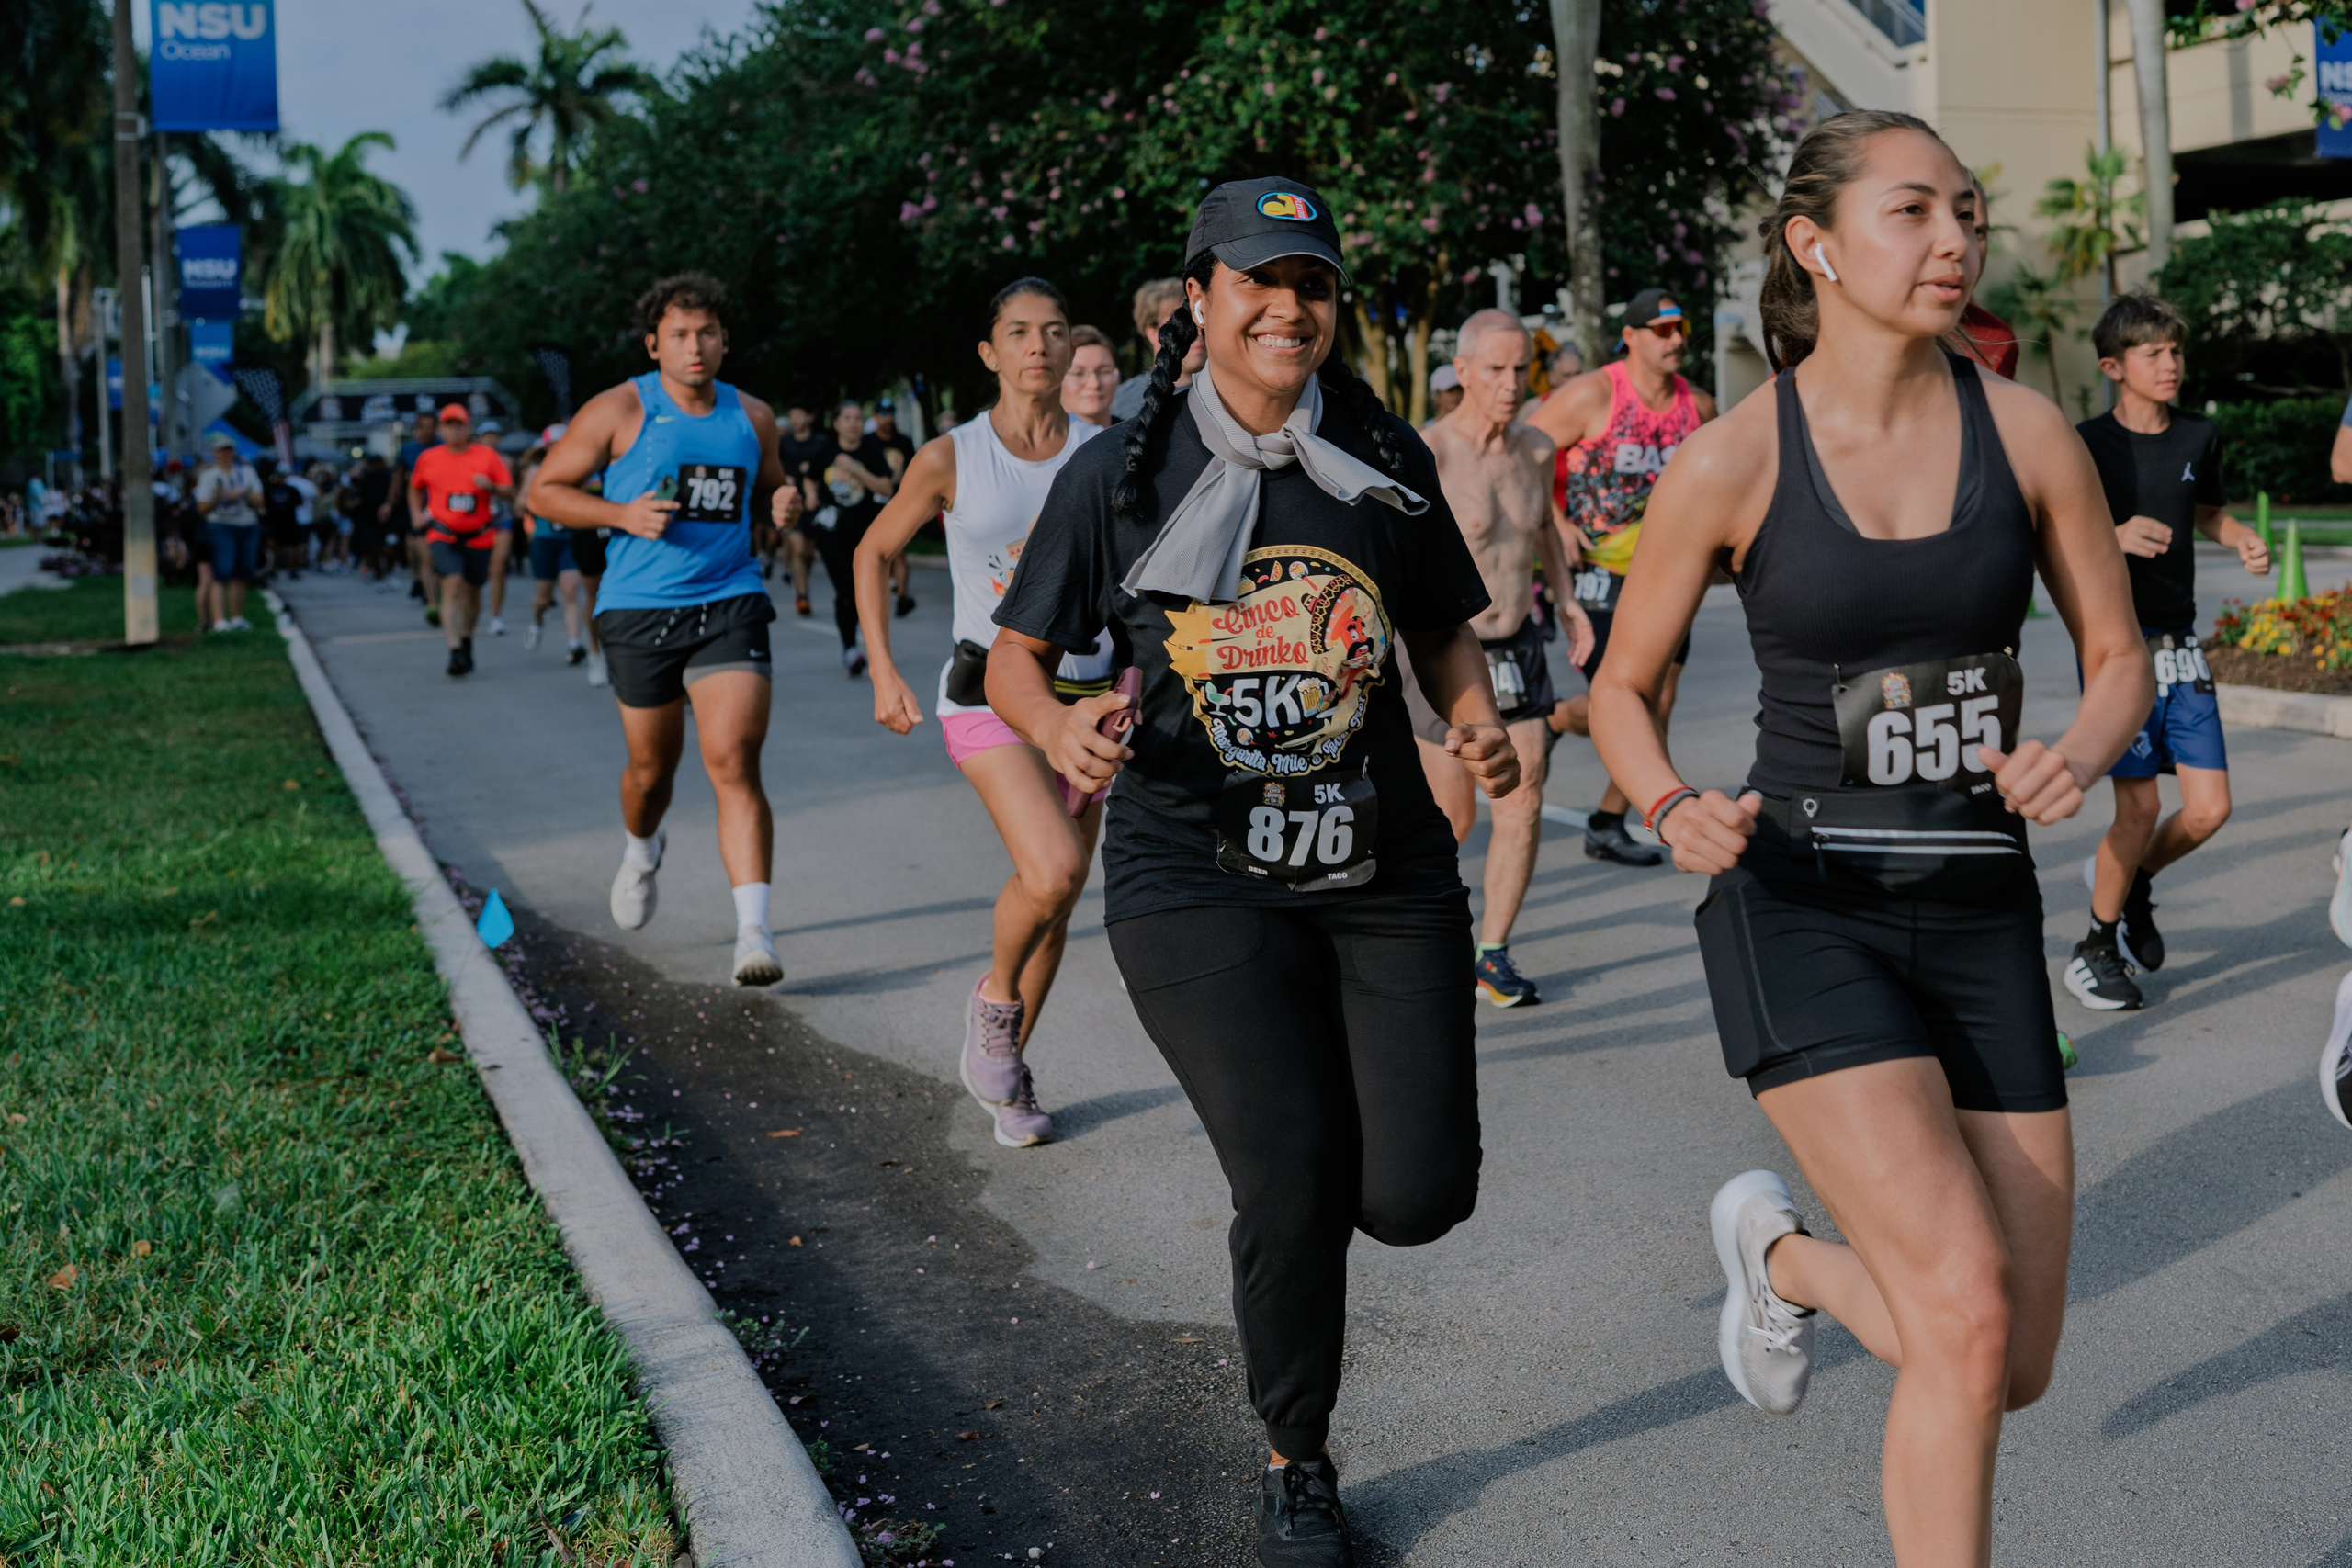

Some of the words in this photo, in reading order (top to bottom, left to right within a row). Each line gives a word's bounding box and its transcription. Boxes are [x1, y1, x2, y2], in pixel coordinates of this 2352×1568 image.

[158, 2, 266, 39] NSU
[160, 39, 231, 61] Ocean
[688, 478, 737, 511] 792
[1212, 596, 1301, 634] Cinco
[1255, 624, 1275, 638] de
[1216, 636, 1309, 670] Drinko
[1947, 667, 1987, 695] 5K
[1232, 674, 1301, 728] 5K
[1211, 718, 1267, 772] Margarita
[1271, 753, 1308, 774] Mile
[1867, 694, 2001, 785] 655
[1314, 783, 1345, 804] 5K
[1247, 805, 1355, 866] 876
[1249, 866, 1268, 875] BEER
[1328, 872, 1348, 880] TACO
